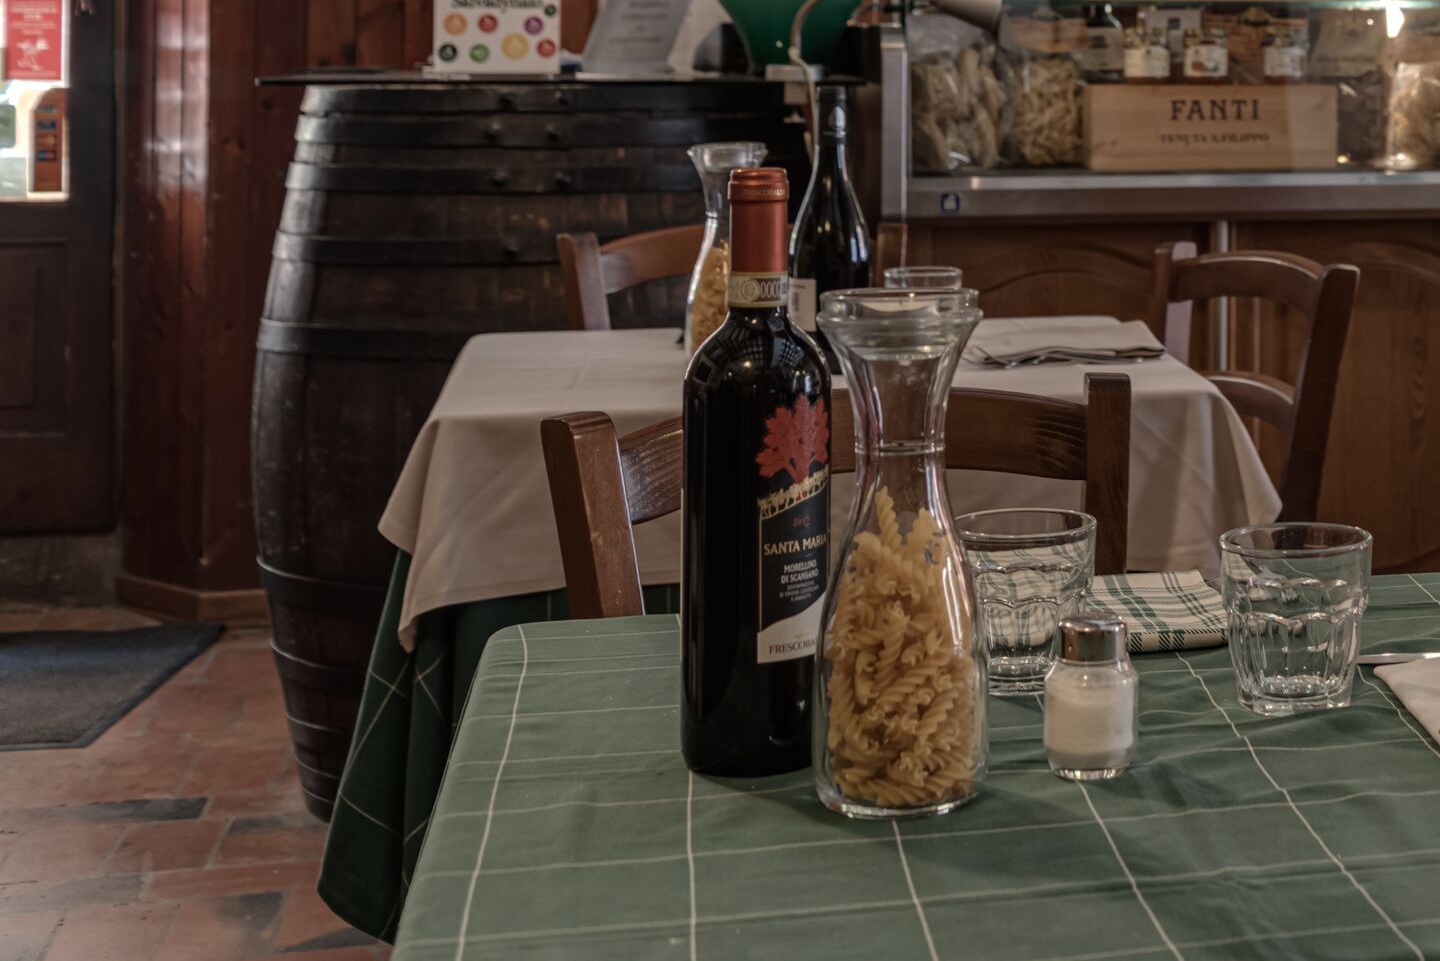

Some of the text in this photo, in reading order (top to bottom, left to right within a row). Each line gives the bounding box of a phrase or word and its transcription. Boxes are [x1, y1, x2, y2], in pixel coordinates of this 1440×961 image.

[1170, 99, 1260, 121] FANTI
[763, 534, 827, 556] SANTA MARIA
[783, 559, 817, 573] MORELLINO
[780, 568, 819, 584] DI SCANSANO
